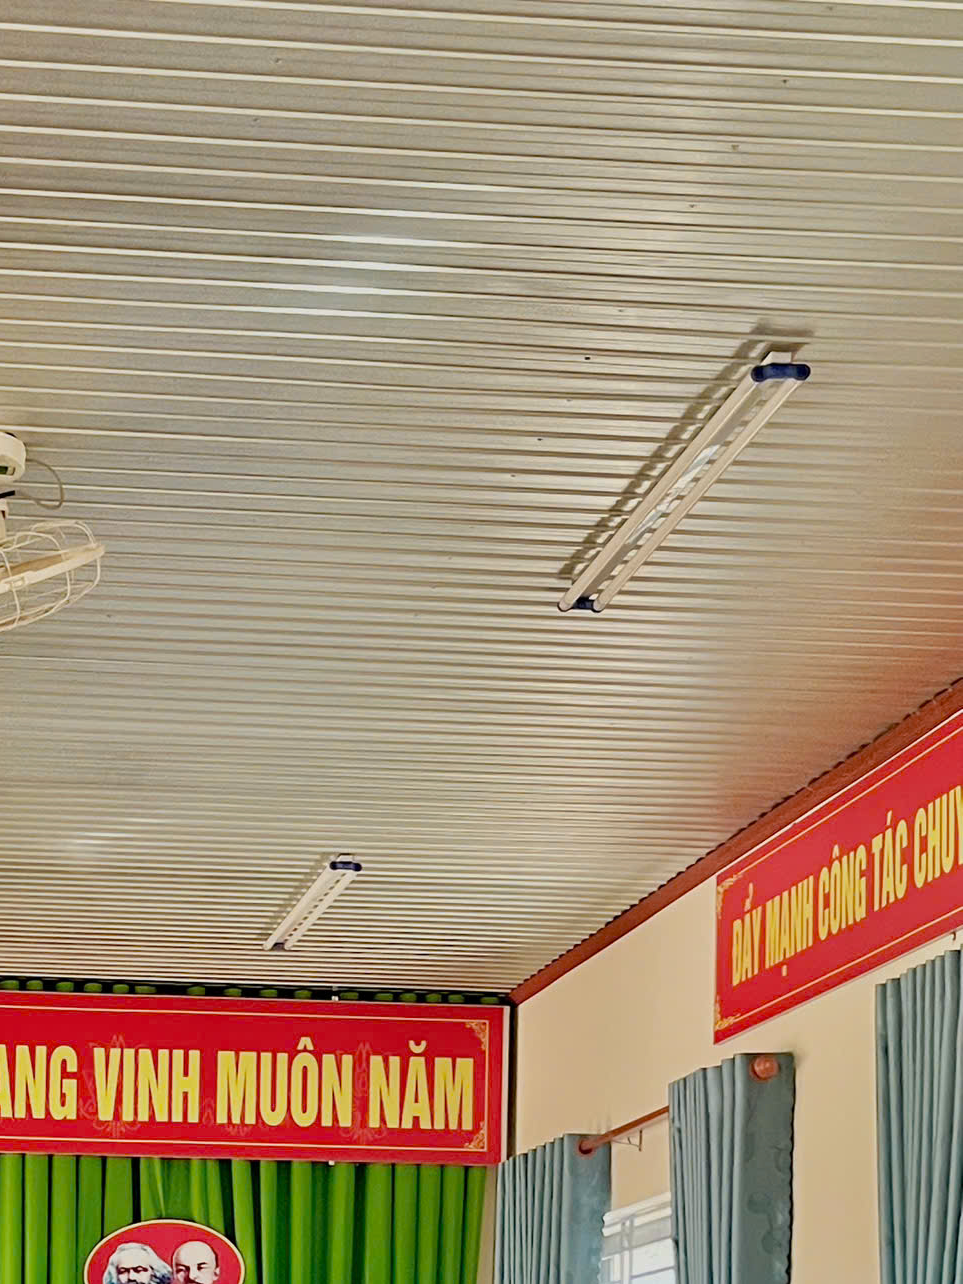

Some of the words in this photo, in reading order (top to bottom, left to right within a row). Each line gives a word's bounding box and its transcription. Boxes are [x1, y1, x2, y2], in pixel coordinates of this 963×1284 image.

[765, 874, 814, 977] MẠNH
[818, 844, 867, 941] CÔNG
[872, 810, 908, 912] TÁC
[93, 1048, 201, 1124] VINH
[216, 1037, 353, 1128] MUÔN
[368, 1040, 474, 1131] NĂM
